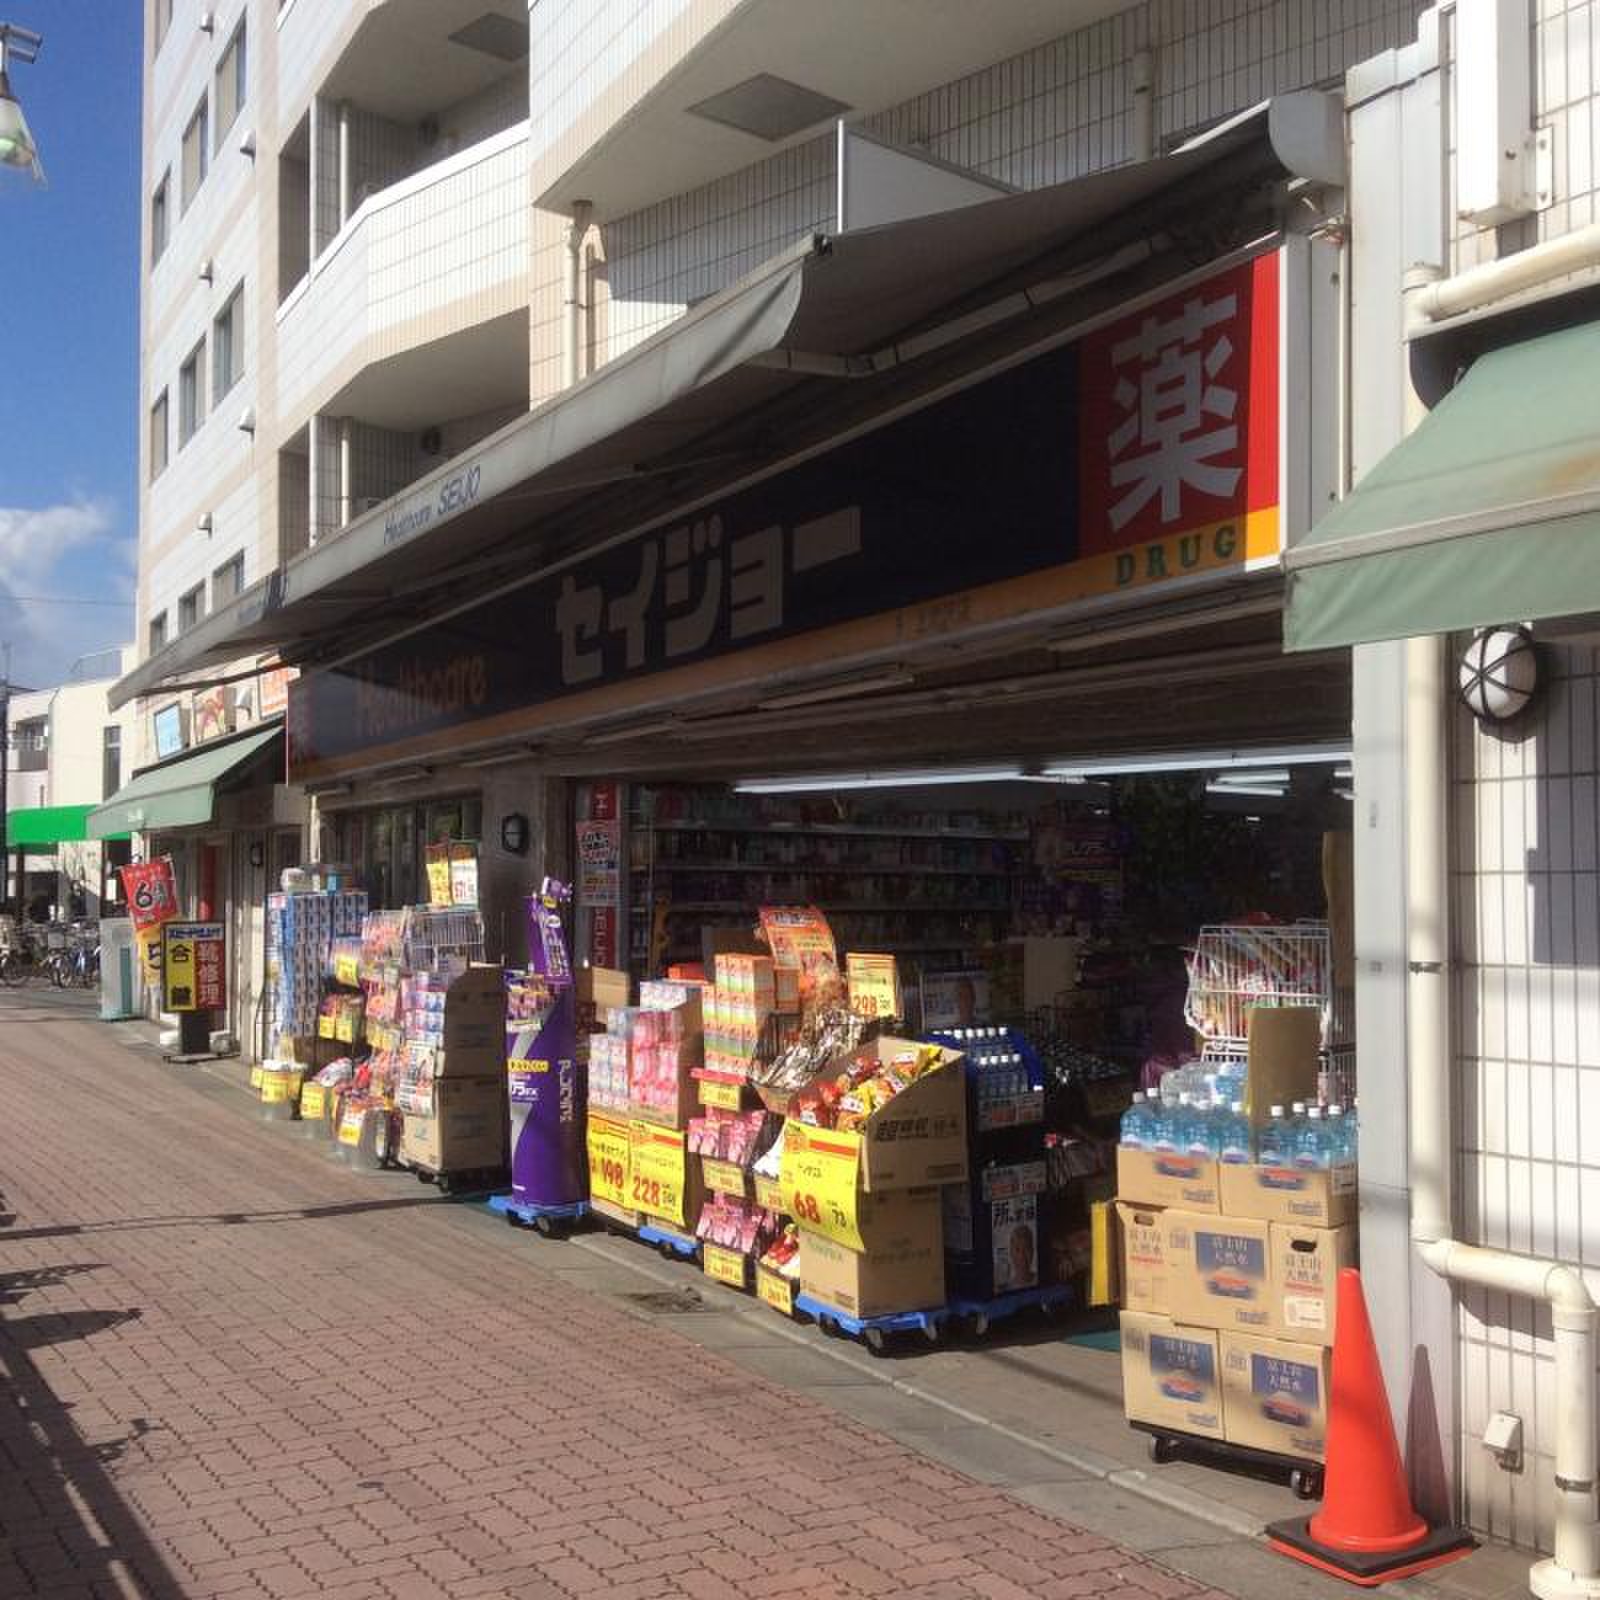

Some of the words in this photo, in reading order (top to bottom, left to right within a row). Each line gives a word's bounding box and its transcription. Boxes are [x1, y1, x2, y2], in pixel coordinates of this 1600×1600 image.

[1107, 293, 1243, 533] 薬
[1115, 524, 1238, 587] DRUG
[555, 503, 864, 687] セイジョー
[356, 654, 488, 738] Healthcare
[632, 1174, 660, 1208] 228
[794, 1190, 822, 1225] 68
